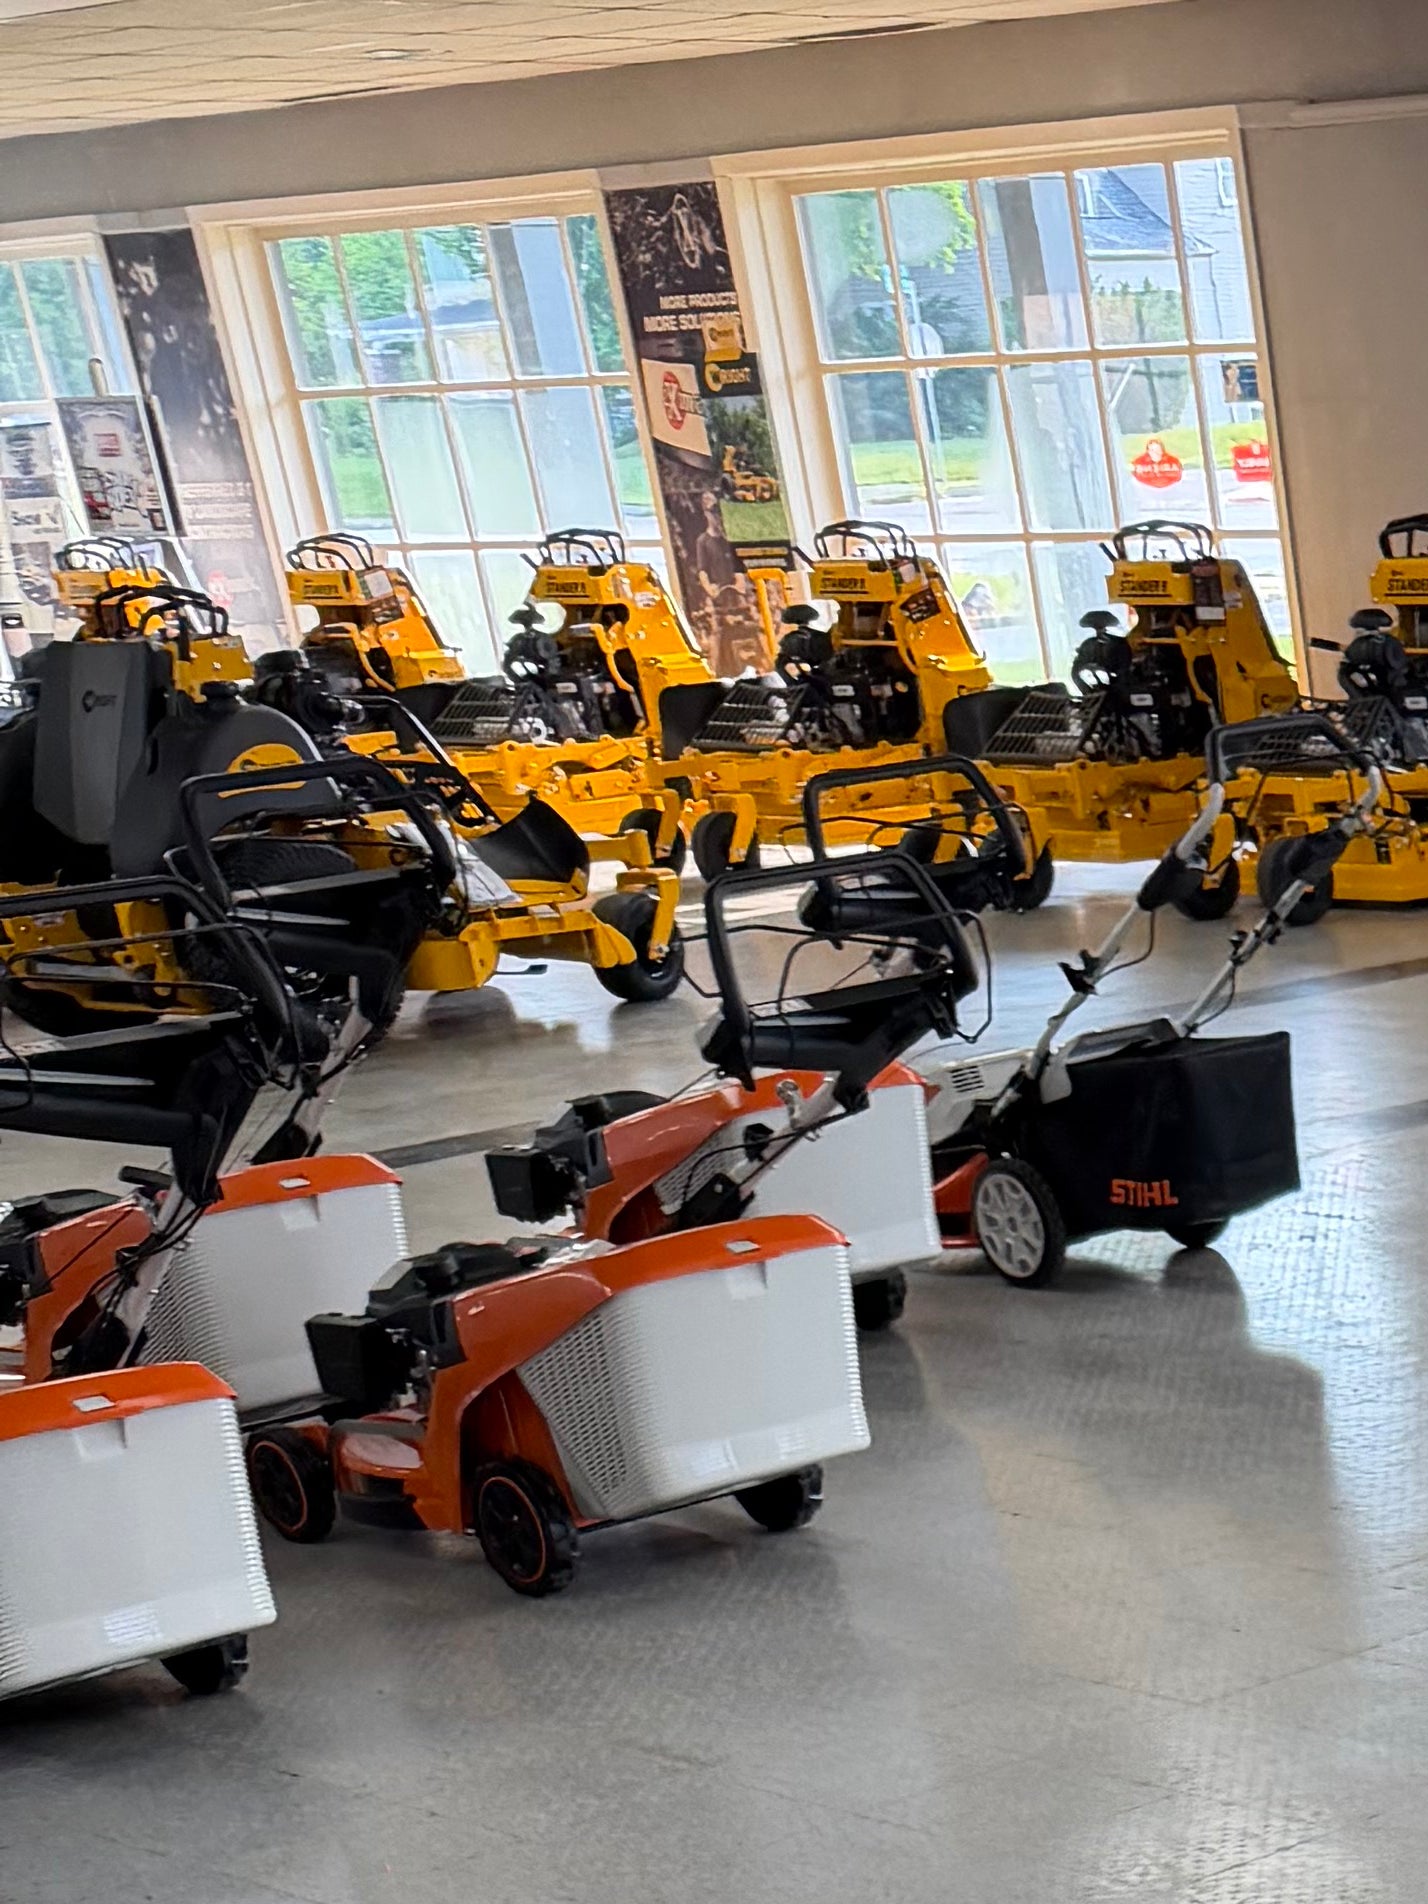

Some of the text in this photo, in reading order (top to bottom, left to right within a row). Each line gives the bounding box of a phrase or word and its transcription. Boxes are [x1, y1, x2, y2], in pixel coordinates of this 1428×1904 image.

[659, 292, 737, 309] MORE PRODUCTS
[643, 315, 678, 332] MORE
[1109, 1178, 1179, 1207] STIHL
